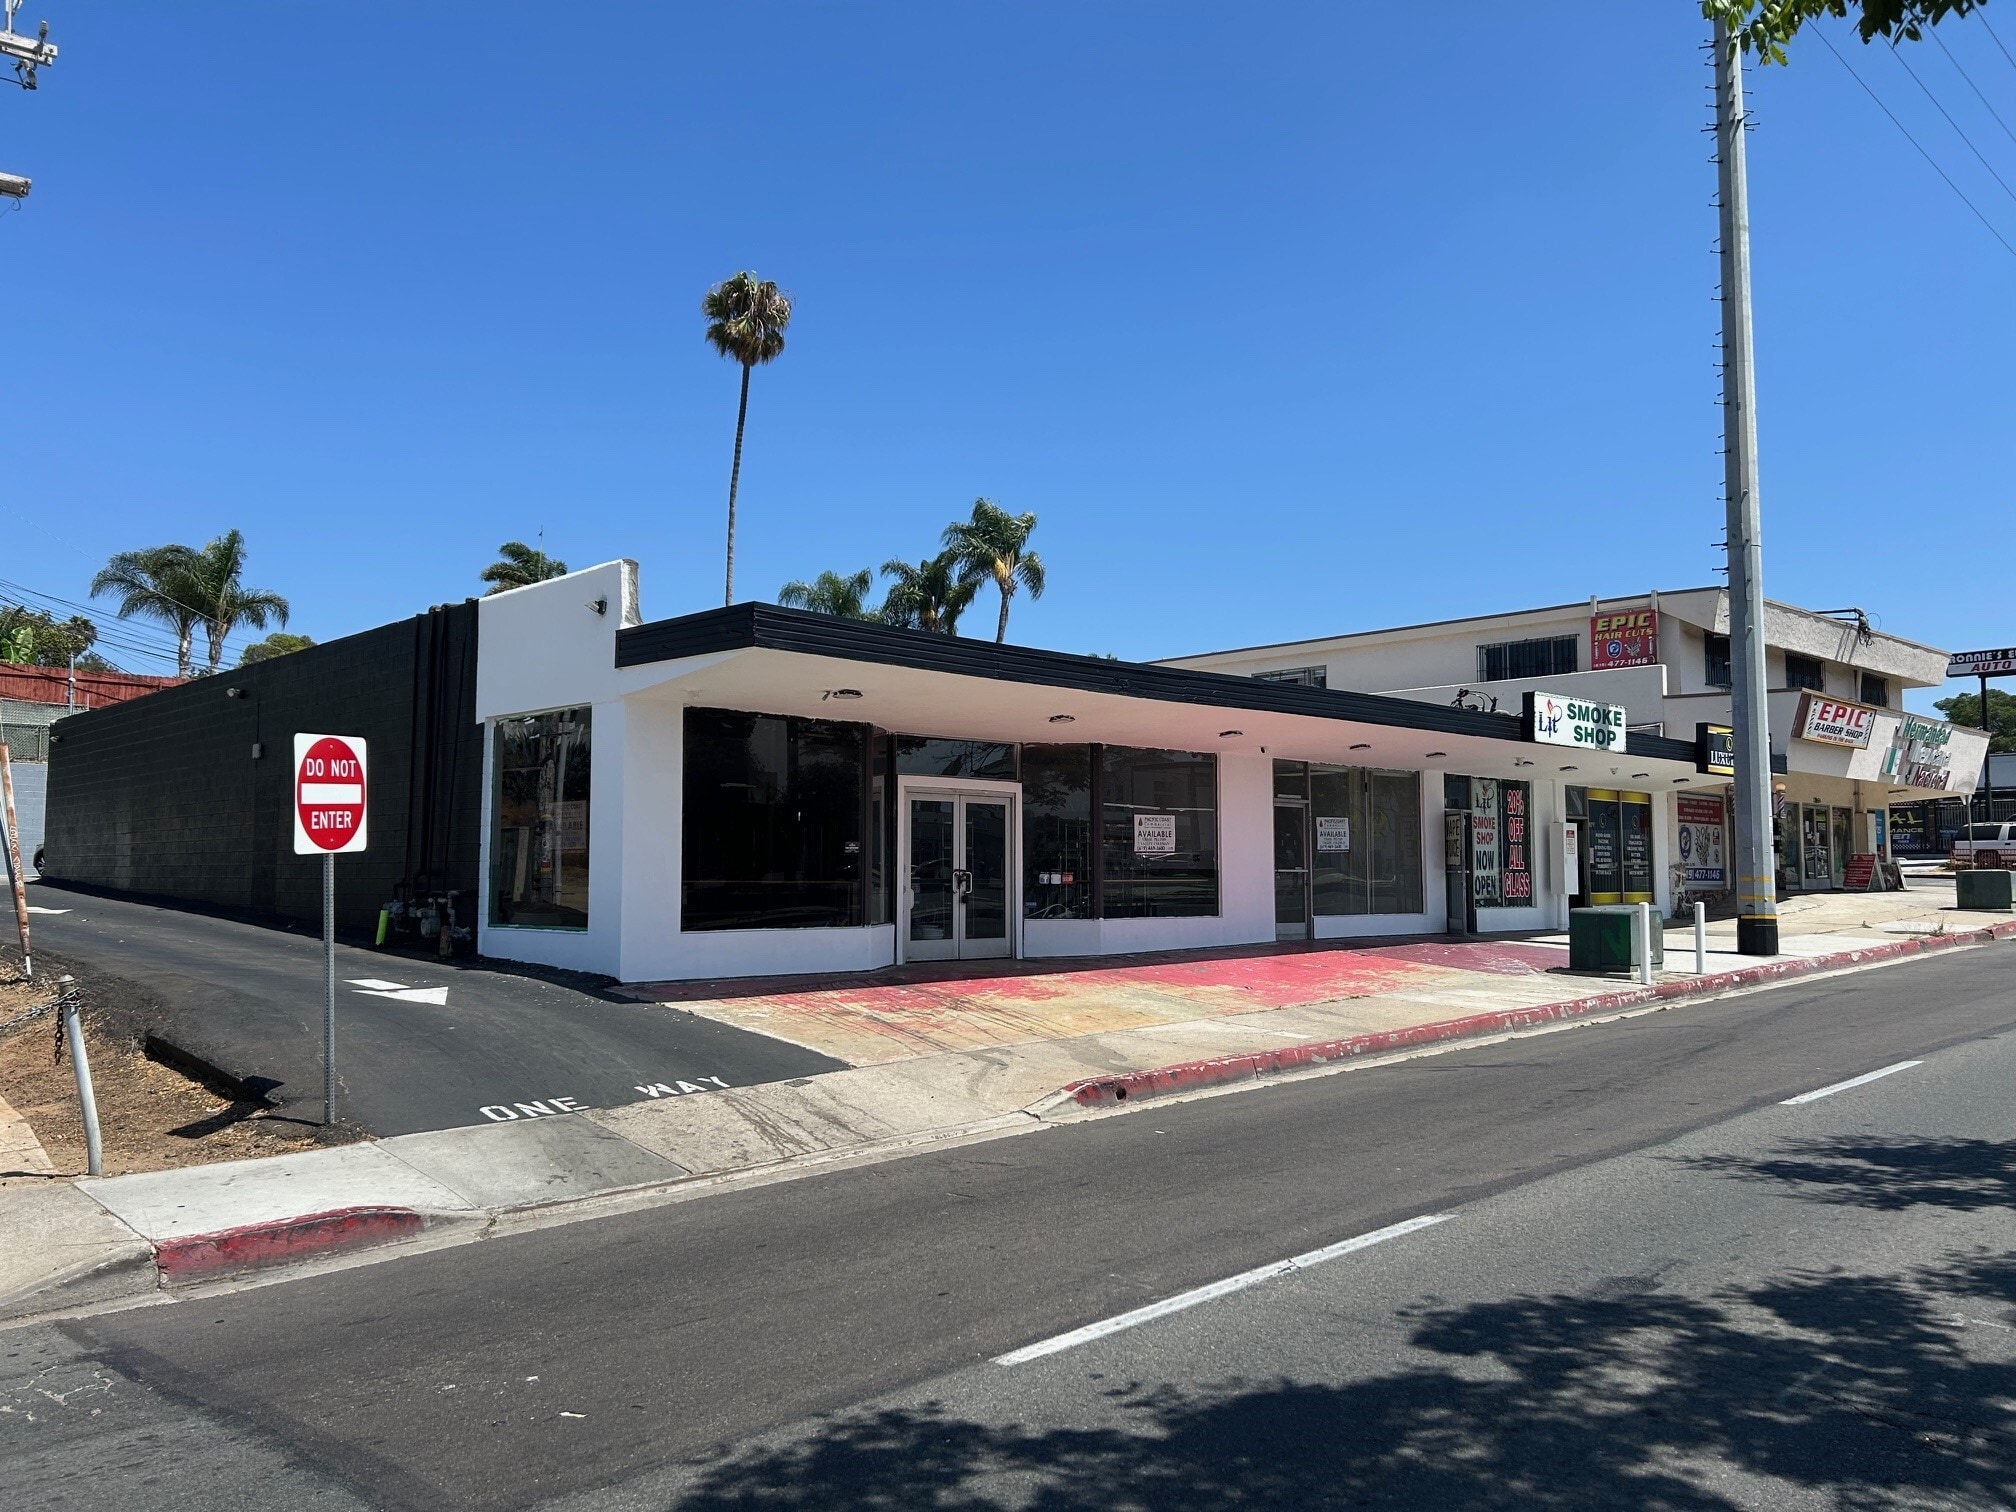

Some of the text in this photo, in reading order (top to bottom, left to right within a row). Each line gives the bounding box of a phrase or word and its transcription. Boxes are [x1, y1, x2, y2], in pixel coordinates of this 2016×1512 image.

[1596, 613, 1652, 632] EPIC
[1595, 627, 1653, 641] HAIR CUTS
[1971, 660, 2012, 673] AUTO
[1566, 702, 1623, 727] SMOKE
[1817, 702, 1868, 728] EPIC
[1573, 725, 1617, 746] SHOP
[1813, 722, 1864, 740] BARBER SHOP
[306, 758, 356, 777] DO NOT
[1506, 789, 1525, 816] 20%
[311, 810, 352, 830] ENTER
[1473, 816, 1496, 830] SMOKE
[1508, 816, 1524, 843] OFF
[1137, 830, 1172, 838] AVAILABLE
[1476, 831, 1494, 845] SHOP
[1475, 850, 1495, 871] NOW
[1508, 844, 1525, 870] ALL
[1474, 875, 1496, 896] OPEN
[1504, 871, 1531, 898] GLASS
[479, 1075, 731, 1122] ONE WAY
